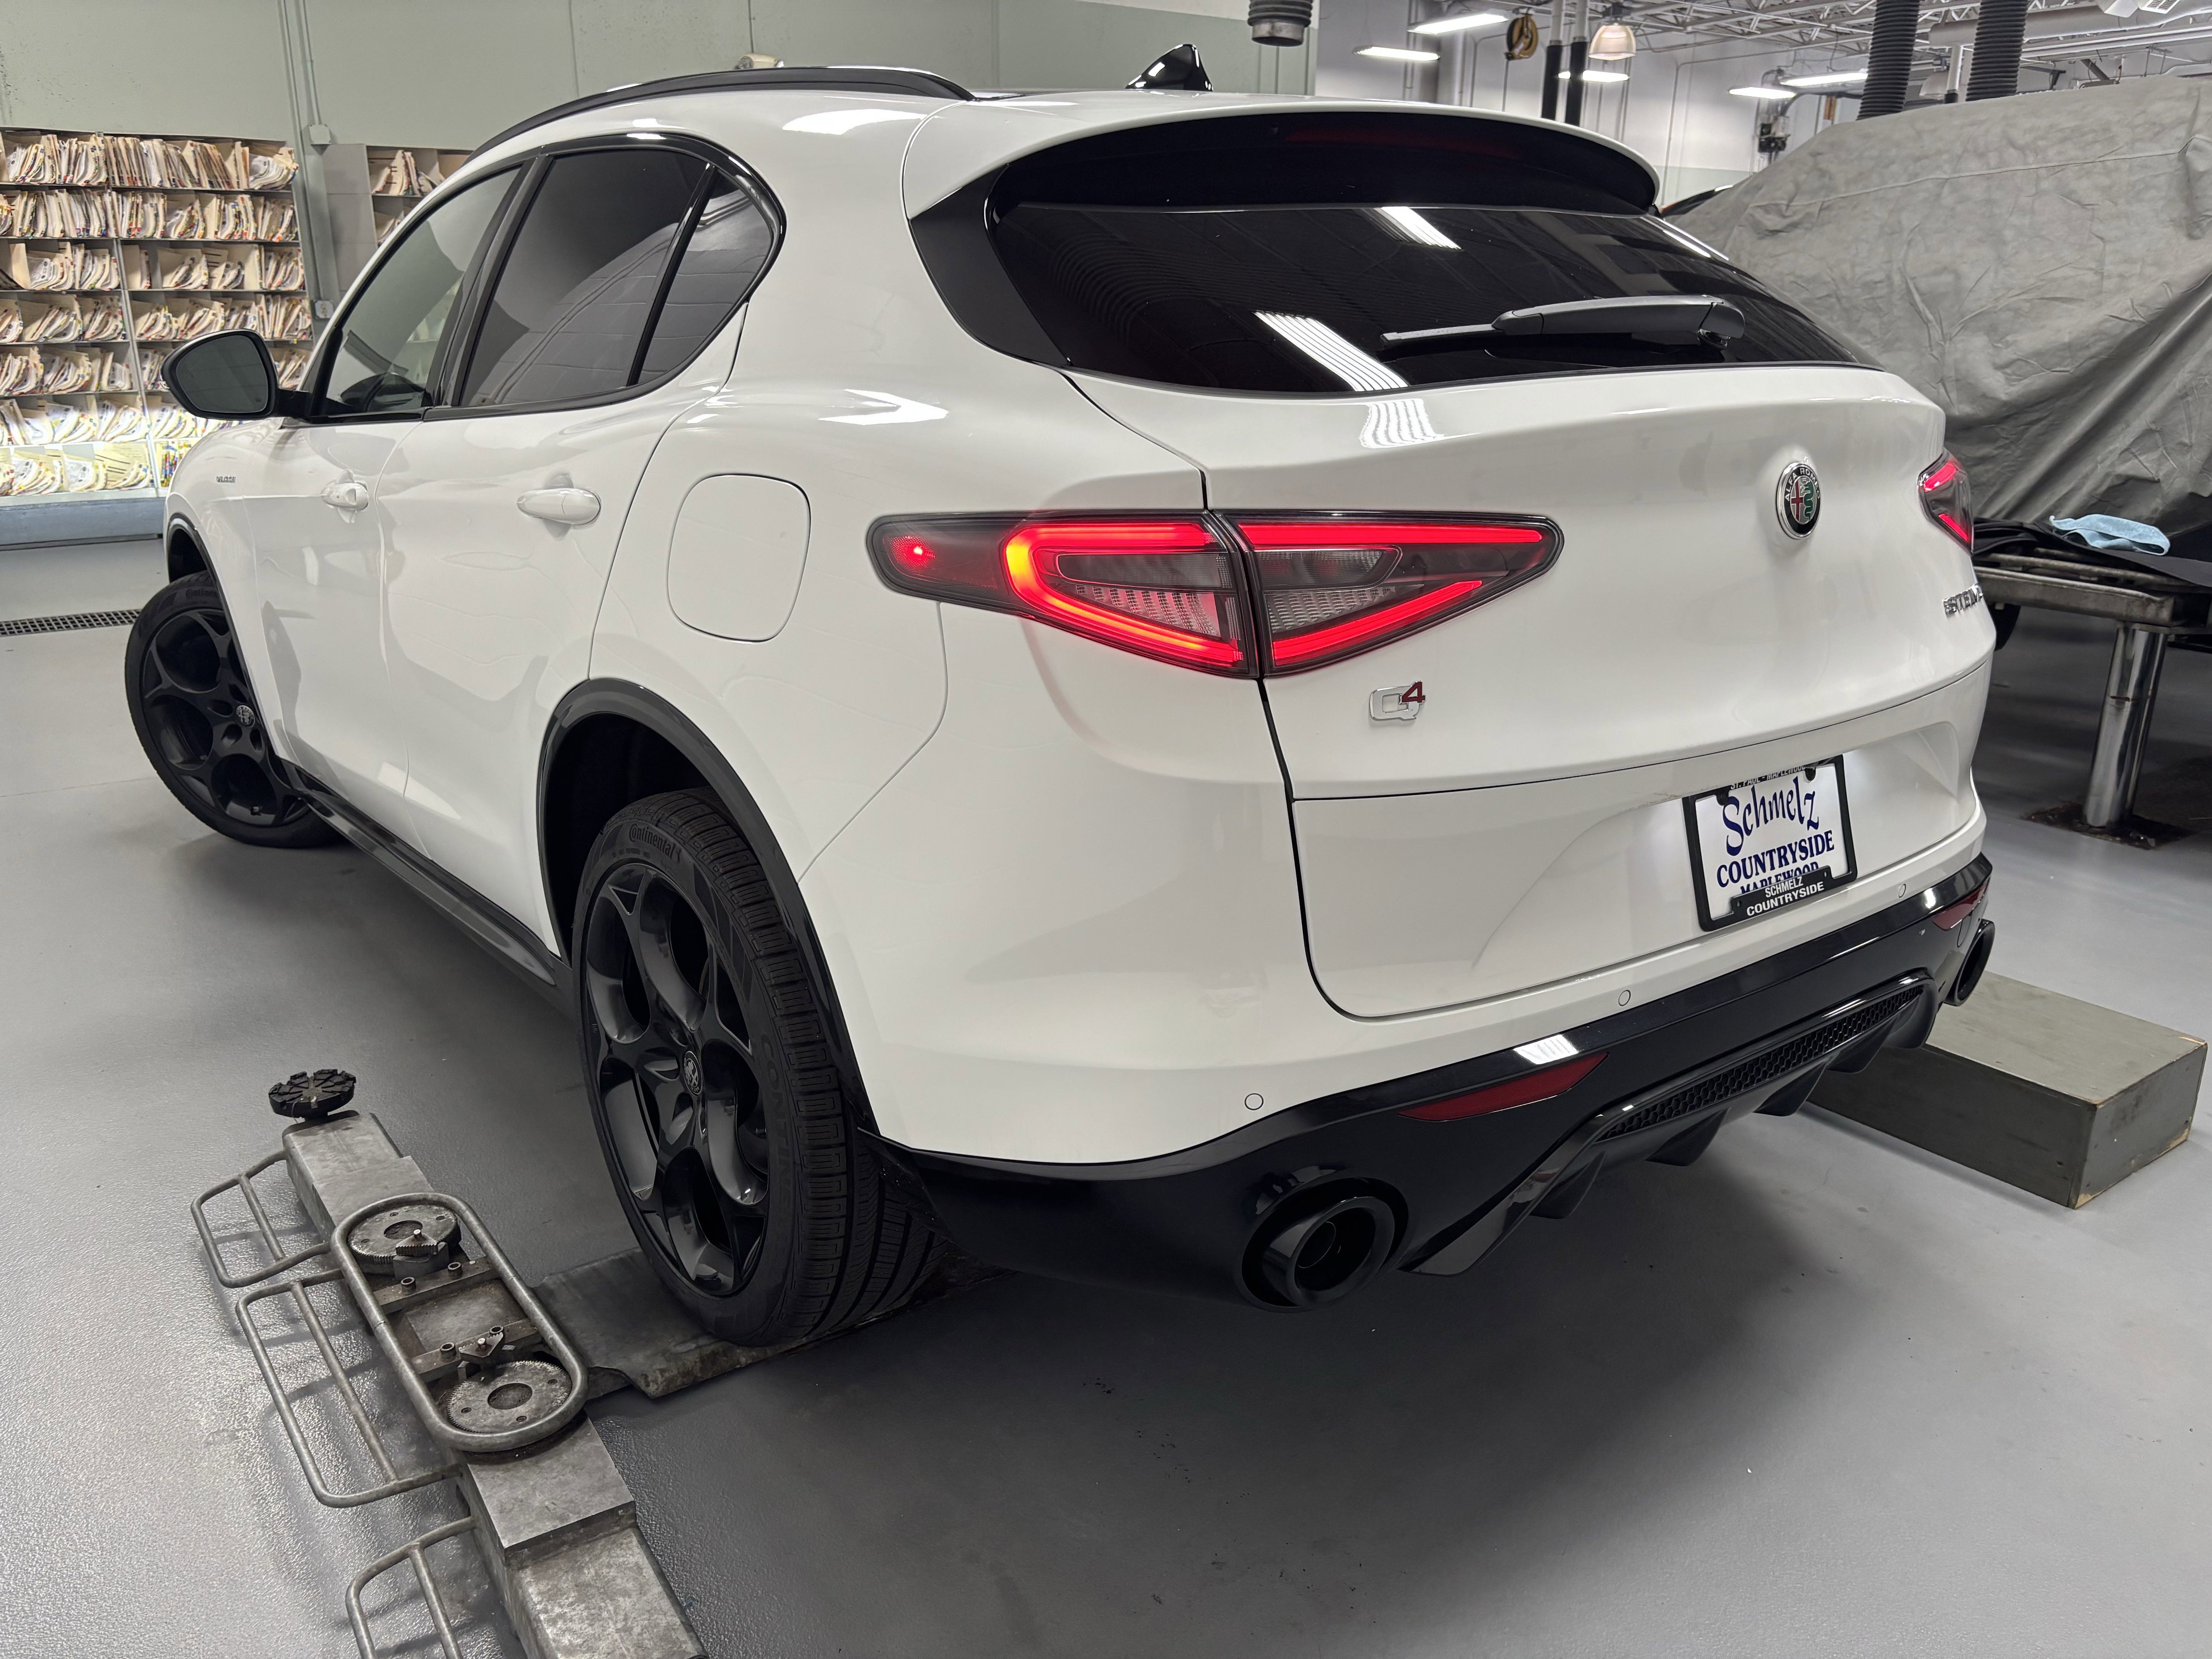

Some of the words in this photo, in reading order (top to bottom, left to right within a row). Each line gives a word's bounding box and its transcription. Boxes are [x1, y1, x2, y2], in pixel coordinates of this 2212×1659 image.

[1785, 472, 1798, 502] ALFA
[1800, 467, 1820, 499] ROMEO
[1722, 776, 1819, 857] Schmelz
[629, 823, 676, 860] Continental
[1716, 830, 1835, 888] COUNTRYSIDE
[1747, 881, 1825, 916] COUNTRYSIDE
[1765, 876, 1804, 898] SCHMELZ
